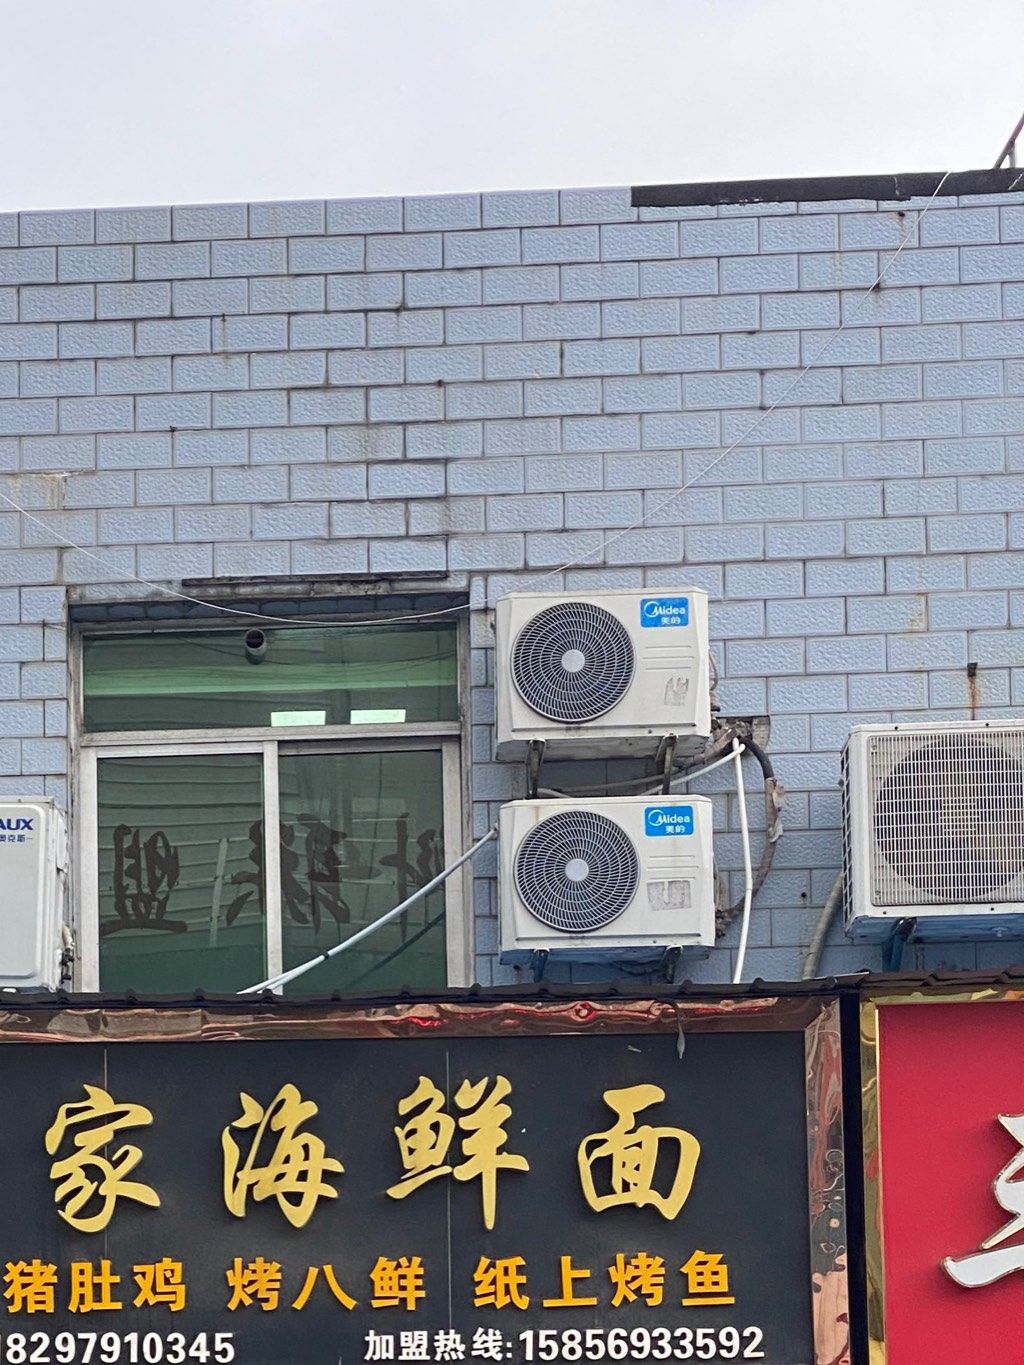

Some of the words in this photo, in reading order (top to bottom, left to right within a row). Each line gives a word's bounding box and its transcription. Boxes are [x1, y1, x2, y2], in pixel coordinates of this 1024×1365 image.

[644, 601, 685, 617] Midea
[661, 616, 681, 625] 美的
[648, 809, 690, 826] Midea
[665, 825, 685, 834] 美的
[2, 1256, 187, 1313] 猪肚鸡
[225, 1255, 427, 1311] 烤八鲜
[472, 1249, 737, 1309] 纸上烤鱼
[364, 1326, 766, 1362] 加盟热线:15856933592
